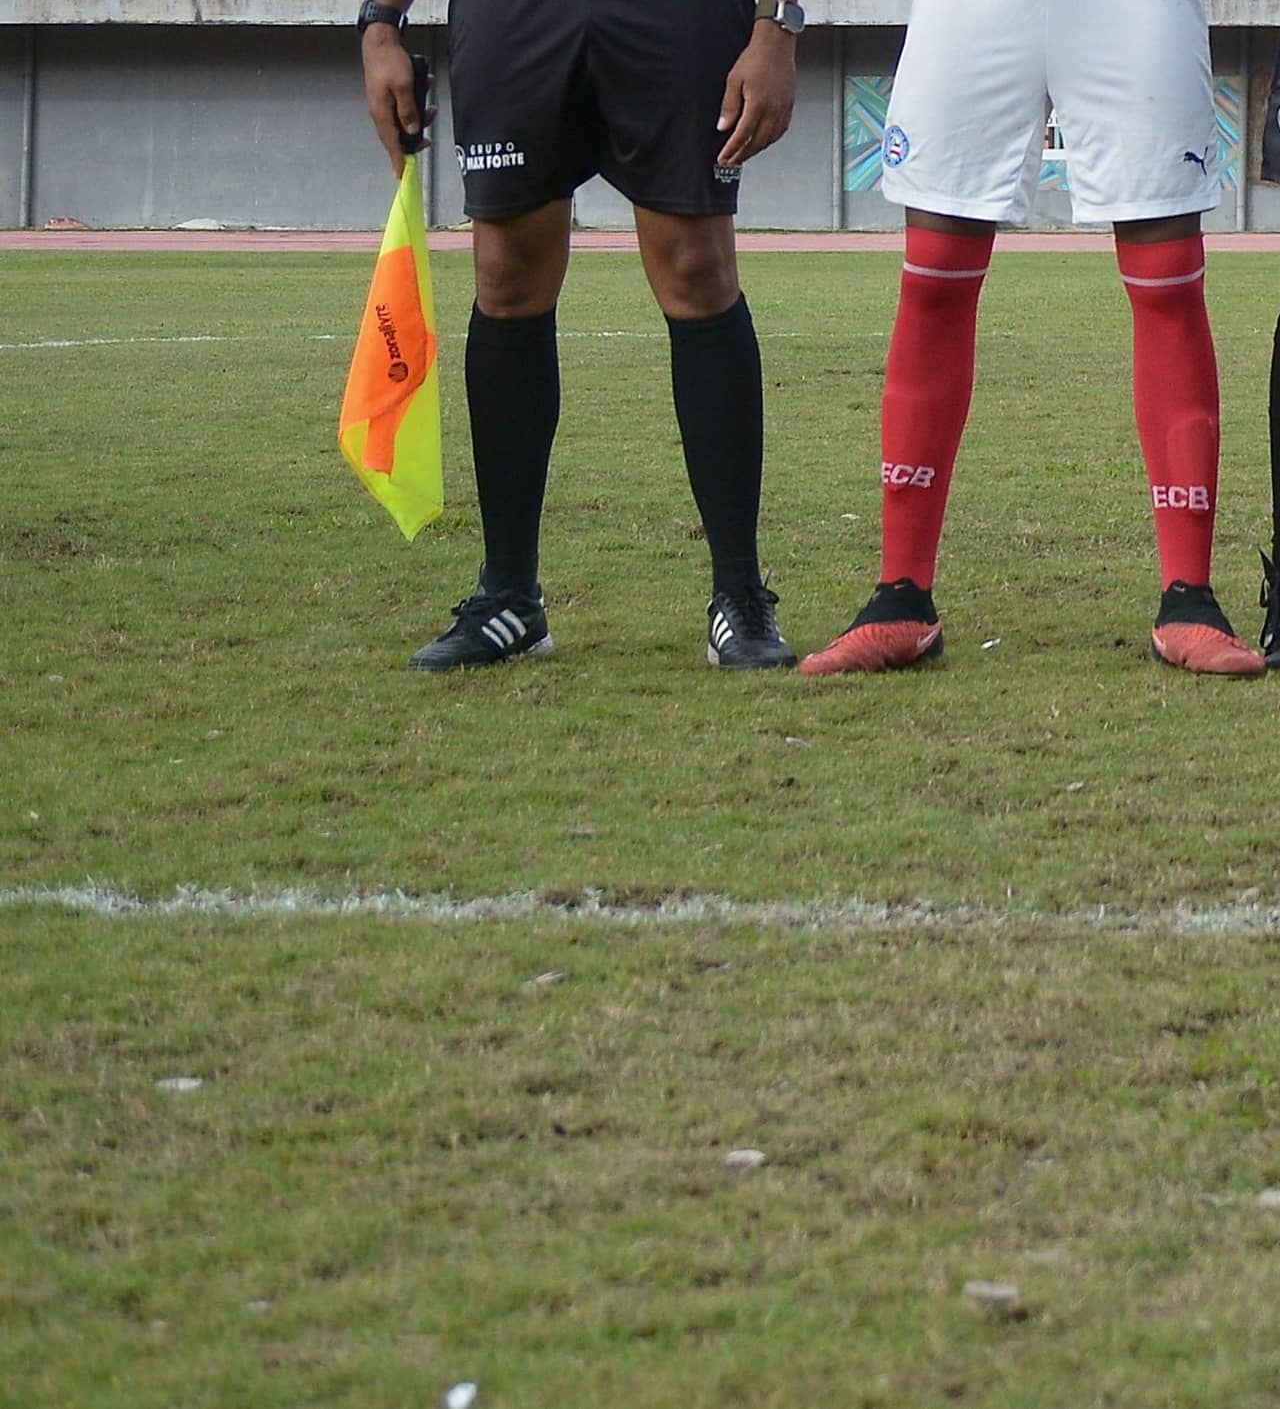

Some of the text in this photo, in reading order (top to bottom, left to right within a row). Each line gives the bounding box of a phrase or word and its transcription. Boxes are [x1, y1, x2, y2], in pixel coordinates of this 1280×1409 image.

[470, 142, 515, 155] GRUPO
[486, 152, 525, 169] FORTE
[880, 462, 936, 488] ECB
[1152, 484, 1211, 511] ECB
